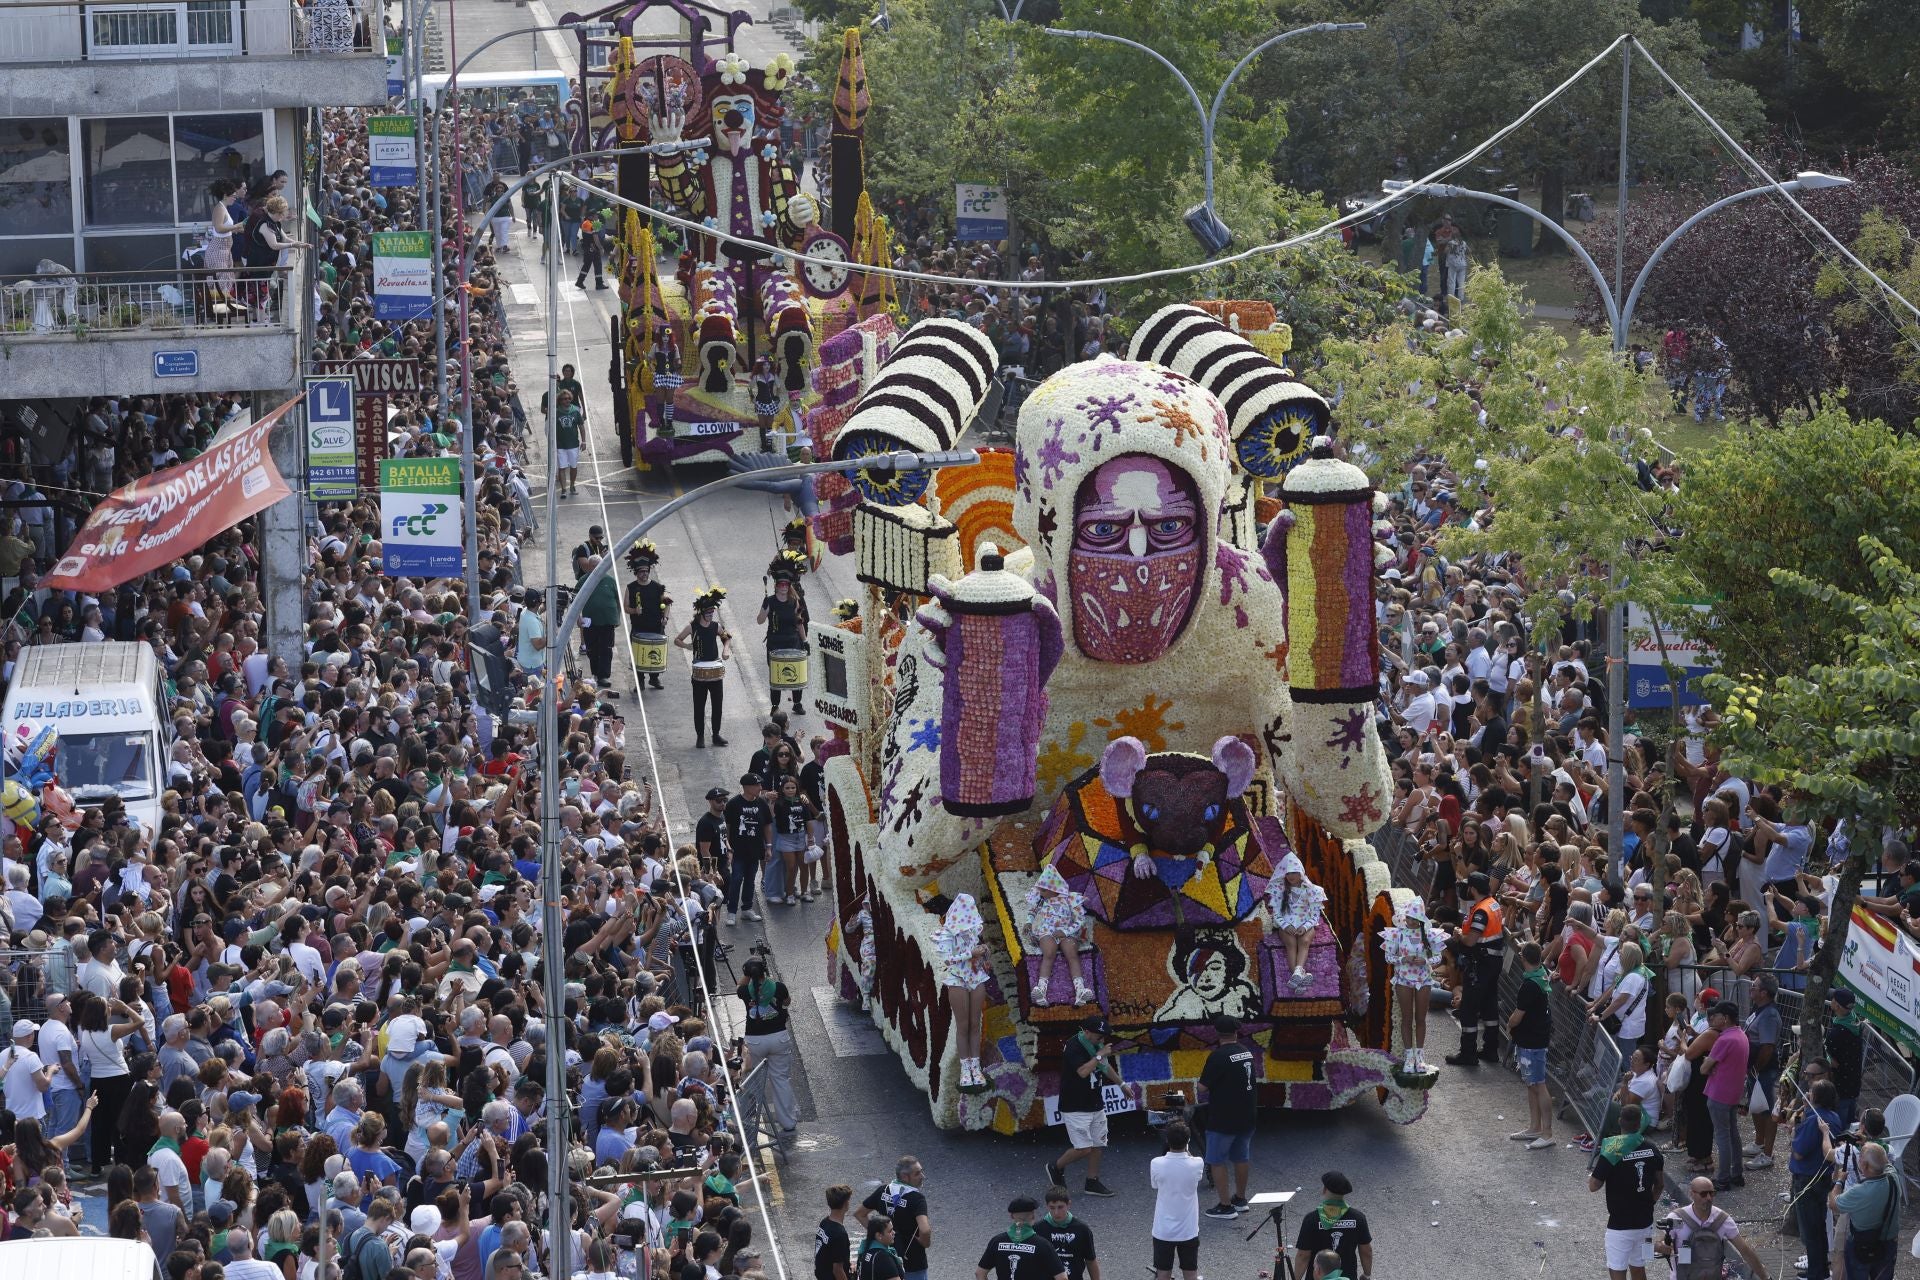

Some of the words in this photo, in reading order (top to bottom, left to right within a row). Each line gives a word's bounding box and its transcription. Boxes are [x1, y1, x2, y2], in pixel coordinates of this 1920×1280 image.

[963, 199, 991, 213] FCC
[379, 237, 424, 246] BATALLA
[814, 241, 826, 251] 12
[380, 245, 390, 253] DE
[393, 245, 424, 253] FLORES
[806, 267, 812, 275] 9
[830, 280, 835, 289] 6
[319, 387, 341, 416] L
[372, 398, 383, 443] ASADOR
[697, 423, 734, 434] CLOWN
[389, 465, 451, 477] BATALLA
[95, 478, 187, 526] MERCADO
[186, 462, 207, 496] DE
[206, 446, 231, 482] LAS
[389, 477, 404, 487] DE
[408, 476, 451, 487] FLORES
[392, 515, 437, 537] FCC
[81, 543, 106, 557] en
[110, 537, 129, 556] la
[134, 518, 186, 552] Semana
[14, 698, 142, 720] HELADERIA
[818, 700, 858, 726] GRABANDO
[1105, 1088, 1118, 1100] AL
